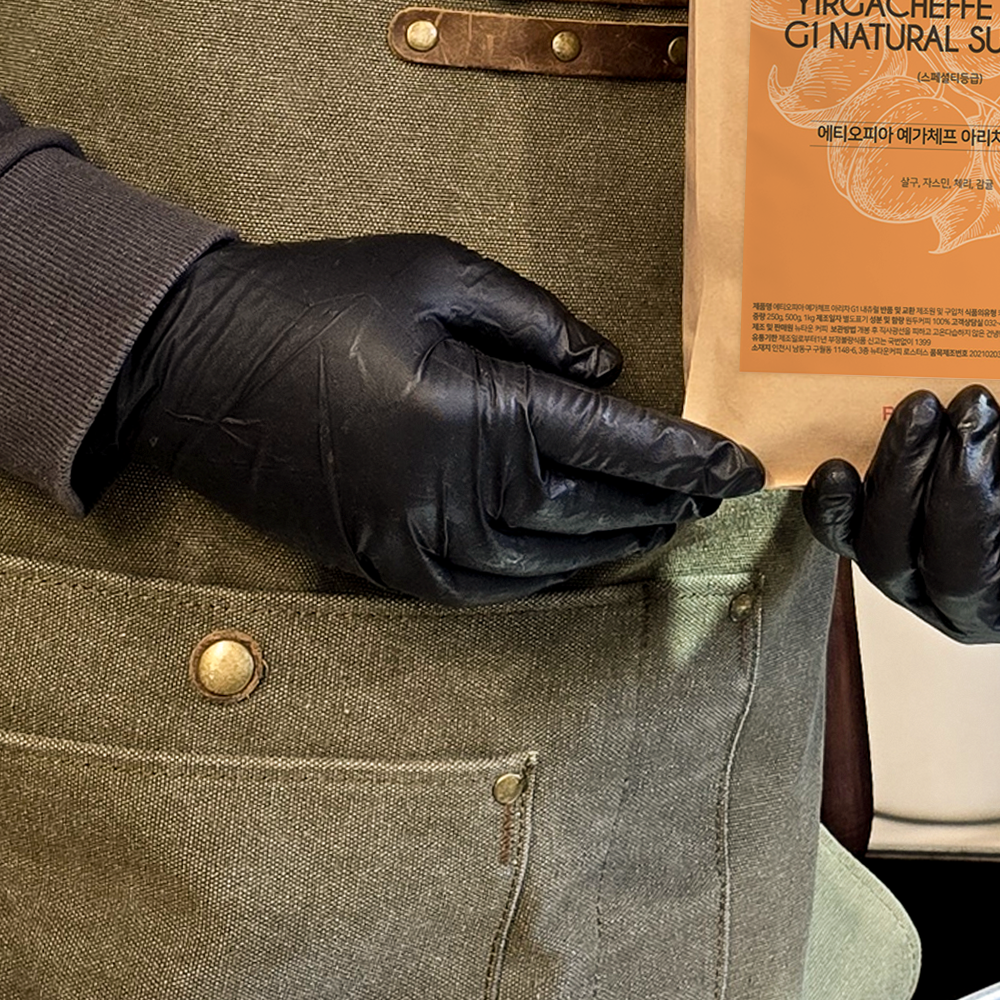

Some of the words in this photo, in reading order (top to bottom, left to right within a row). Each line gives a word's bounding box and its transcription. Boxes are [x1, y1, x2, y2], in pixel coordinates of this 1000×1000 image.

[785, 21, 818, 48] G1
[830, 22, 959, 52] NATURAL
[917, 72, 983, 84] (스페셜티등급)
[817, 125, 894, 144] 에티오피아
[896, 127, 958, 145] 예가체프
[752, 302, 772, 311] 제품명
[804, 314, 815, 322] 1kg
[842, 315, 868, 323] 별도표기
[869, 315, 882, 324] 성분
[906, 316, 931, 325] 원두커피
[932, 317, 950, 325] 100%
[751, 322, 765, 331] 제조
[795, 324, 813, 332] 뉴타운
[830, 325, 856, 334] 보관방법
[867, 337, 886, 345] 신고는
[915, 338, 931, 346] 1399
[771, 344, 791, 352] 인천시
[792, 345, 811, 353] 남동구
[858, 346, 869, 355] 3층
[903, 348, 929, 356] 로스터스
